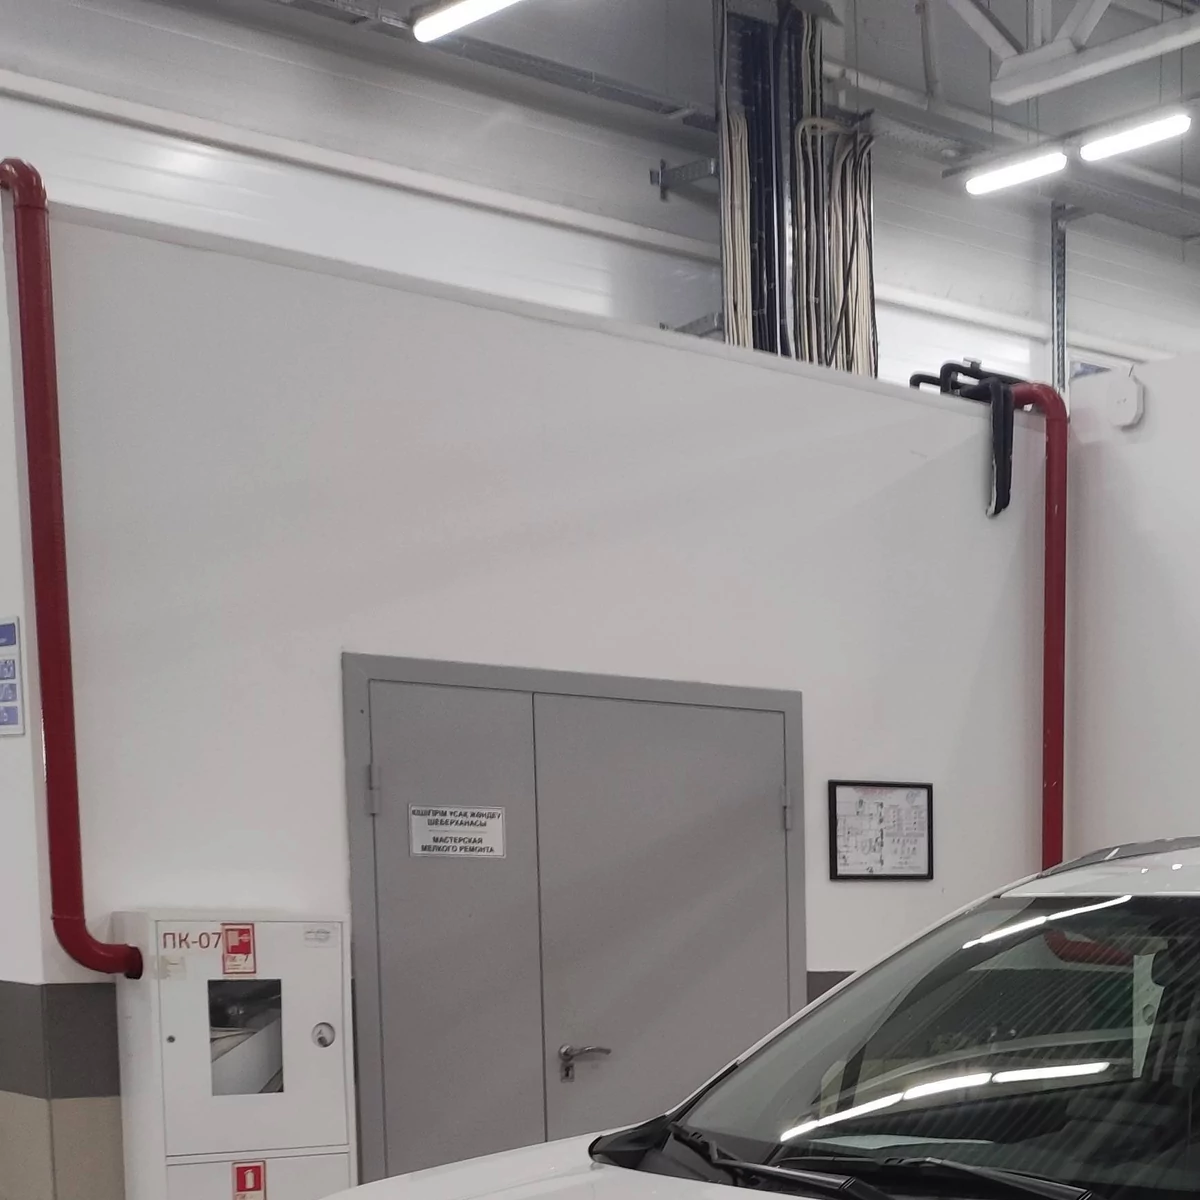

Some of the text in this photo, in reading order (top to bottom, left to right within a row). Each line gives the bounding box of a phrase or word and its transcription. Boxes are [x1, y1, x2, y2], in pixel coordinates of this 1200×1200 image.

[432, 836, 483, 844] МАСТЕРСКАЯ
[459, 845, 495, 853] РЕМОНТА
[162, 932, 222, 949] ПК-07
